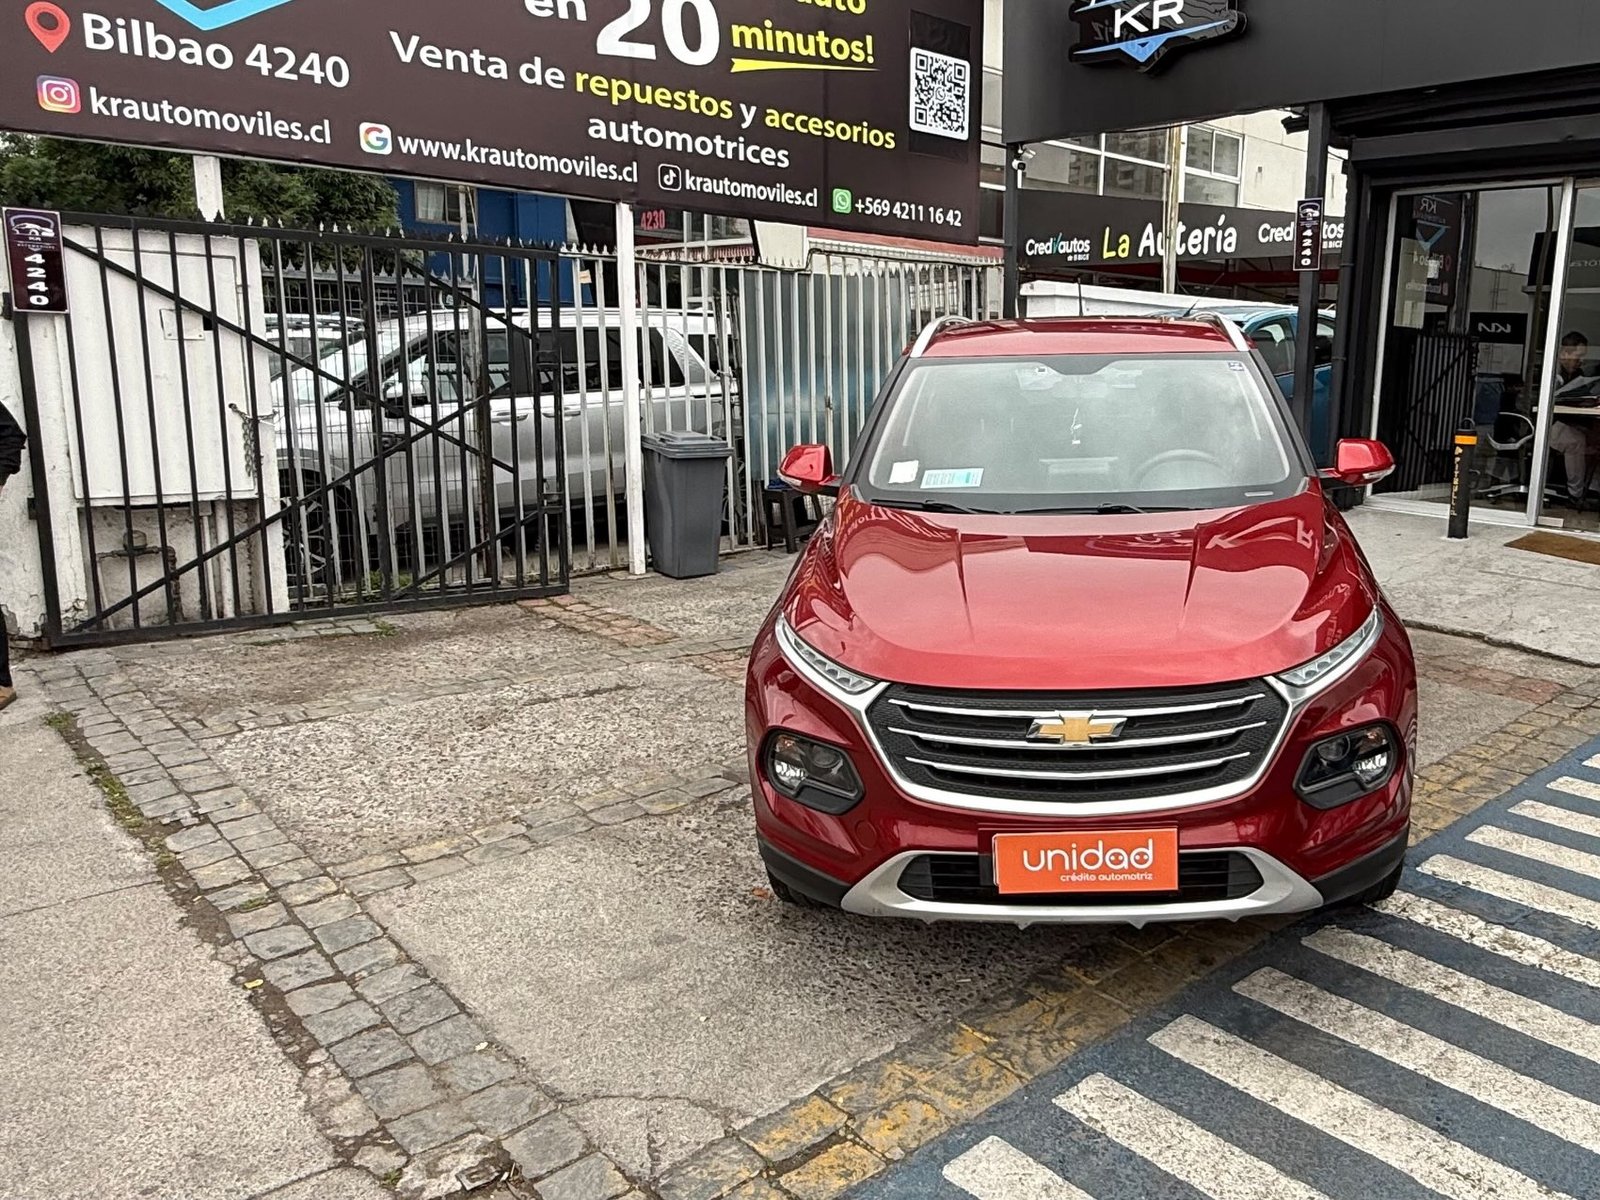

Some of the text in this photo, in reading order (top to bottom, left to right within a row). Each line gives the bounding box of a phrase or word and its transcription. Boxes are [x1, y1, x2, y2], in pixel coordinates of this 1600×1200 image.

[596, 0, 720, 66] 20
[1114, 0, 1184, 38] KR
[82, 12, 349, 88] Bilbao 4240
[731, 20, 874, 64] minutos!
[389, 30, 896, 149] Venta de repuestos y accesorios
[89, 87, 331, 144] krautomoviles.cl
[397, 135, 638, 183] www.krautomoviles.cl
[588, 117, 790, 168] automotrices
[685, 169, 818, 208] krautomoviles.cl
[641, 209, 665, 230] 4230
[855, 197, 890, 217] +569
[892, 200, 924, 222] 4211
[1102, 226, 1130, 259] La
[1301, 229, 1313, 266] 4240
[24, 253, 49, 306] 4240
[1022, 838, 1153, 871] unidad
[1060, 871, 1153, 883] crédito automotriz
